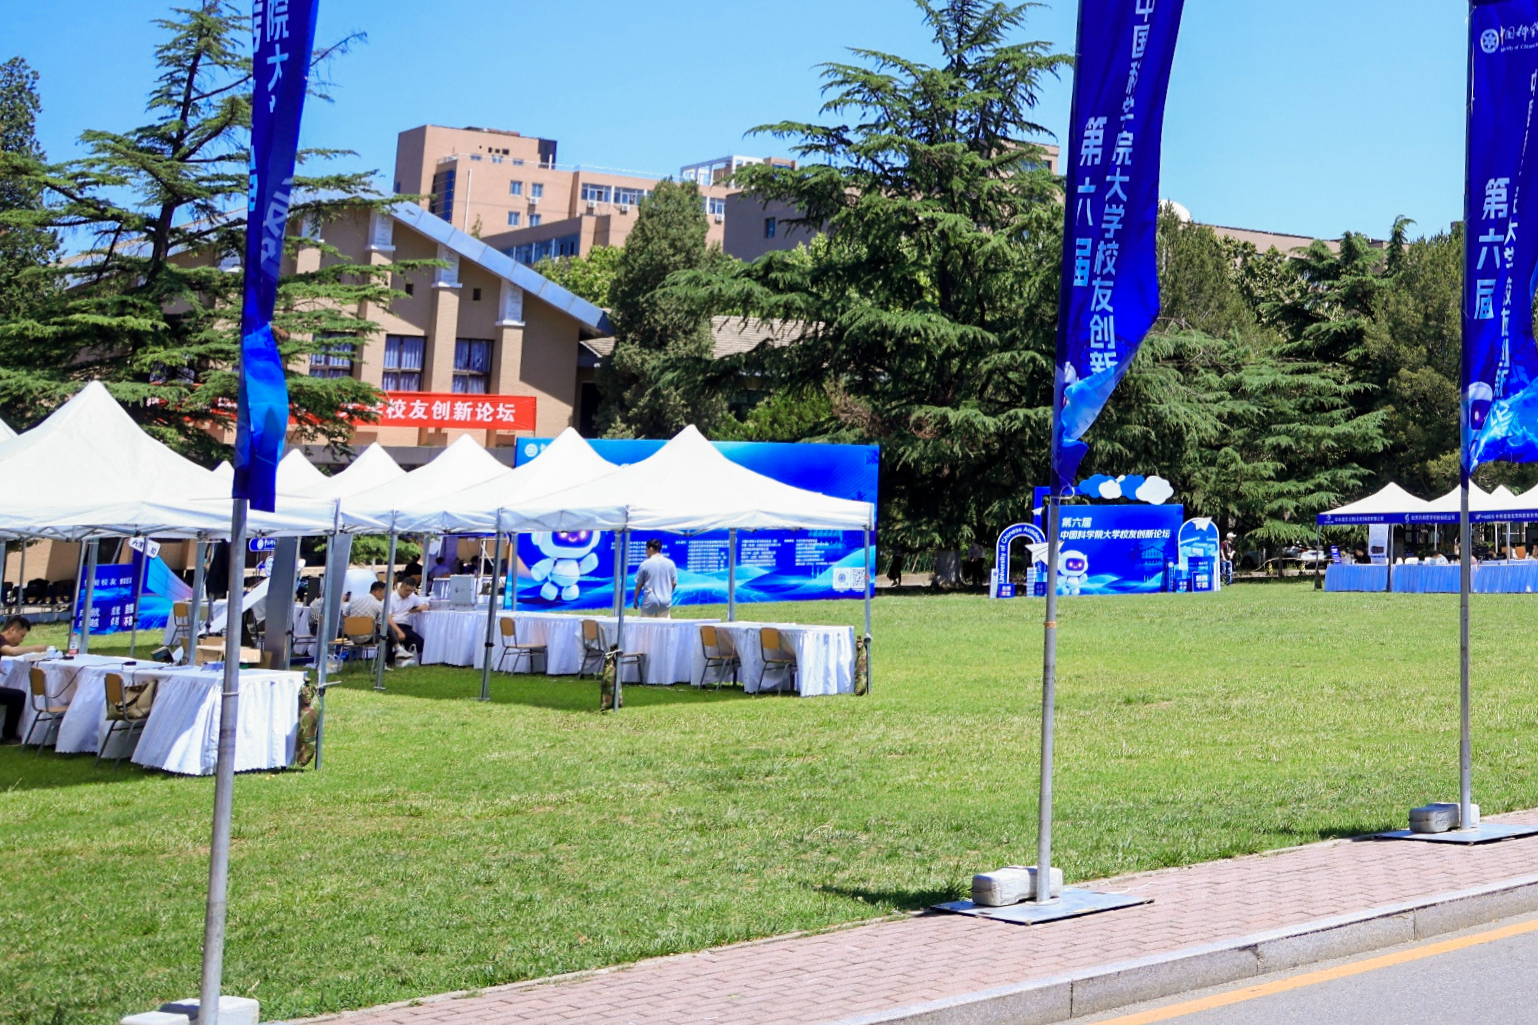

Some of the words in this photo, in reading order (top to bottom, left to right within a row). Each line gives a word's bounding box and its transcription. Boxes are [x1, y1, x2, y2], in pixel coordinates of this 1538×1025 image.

[1473, 177, 1511, 319] 第六届
[1061, 517, 1092, 528] 第六届
[1023, 526, 1042, 543] Academ
[1060, 528, 1170, 540] 中国科学院大学校友创新论坛
